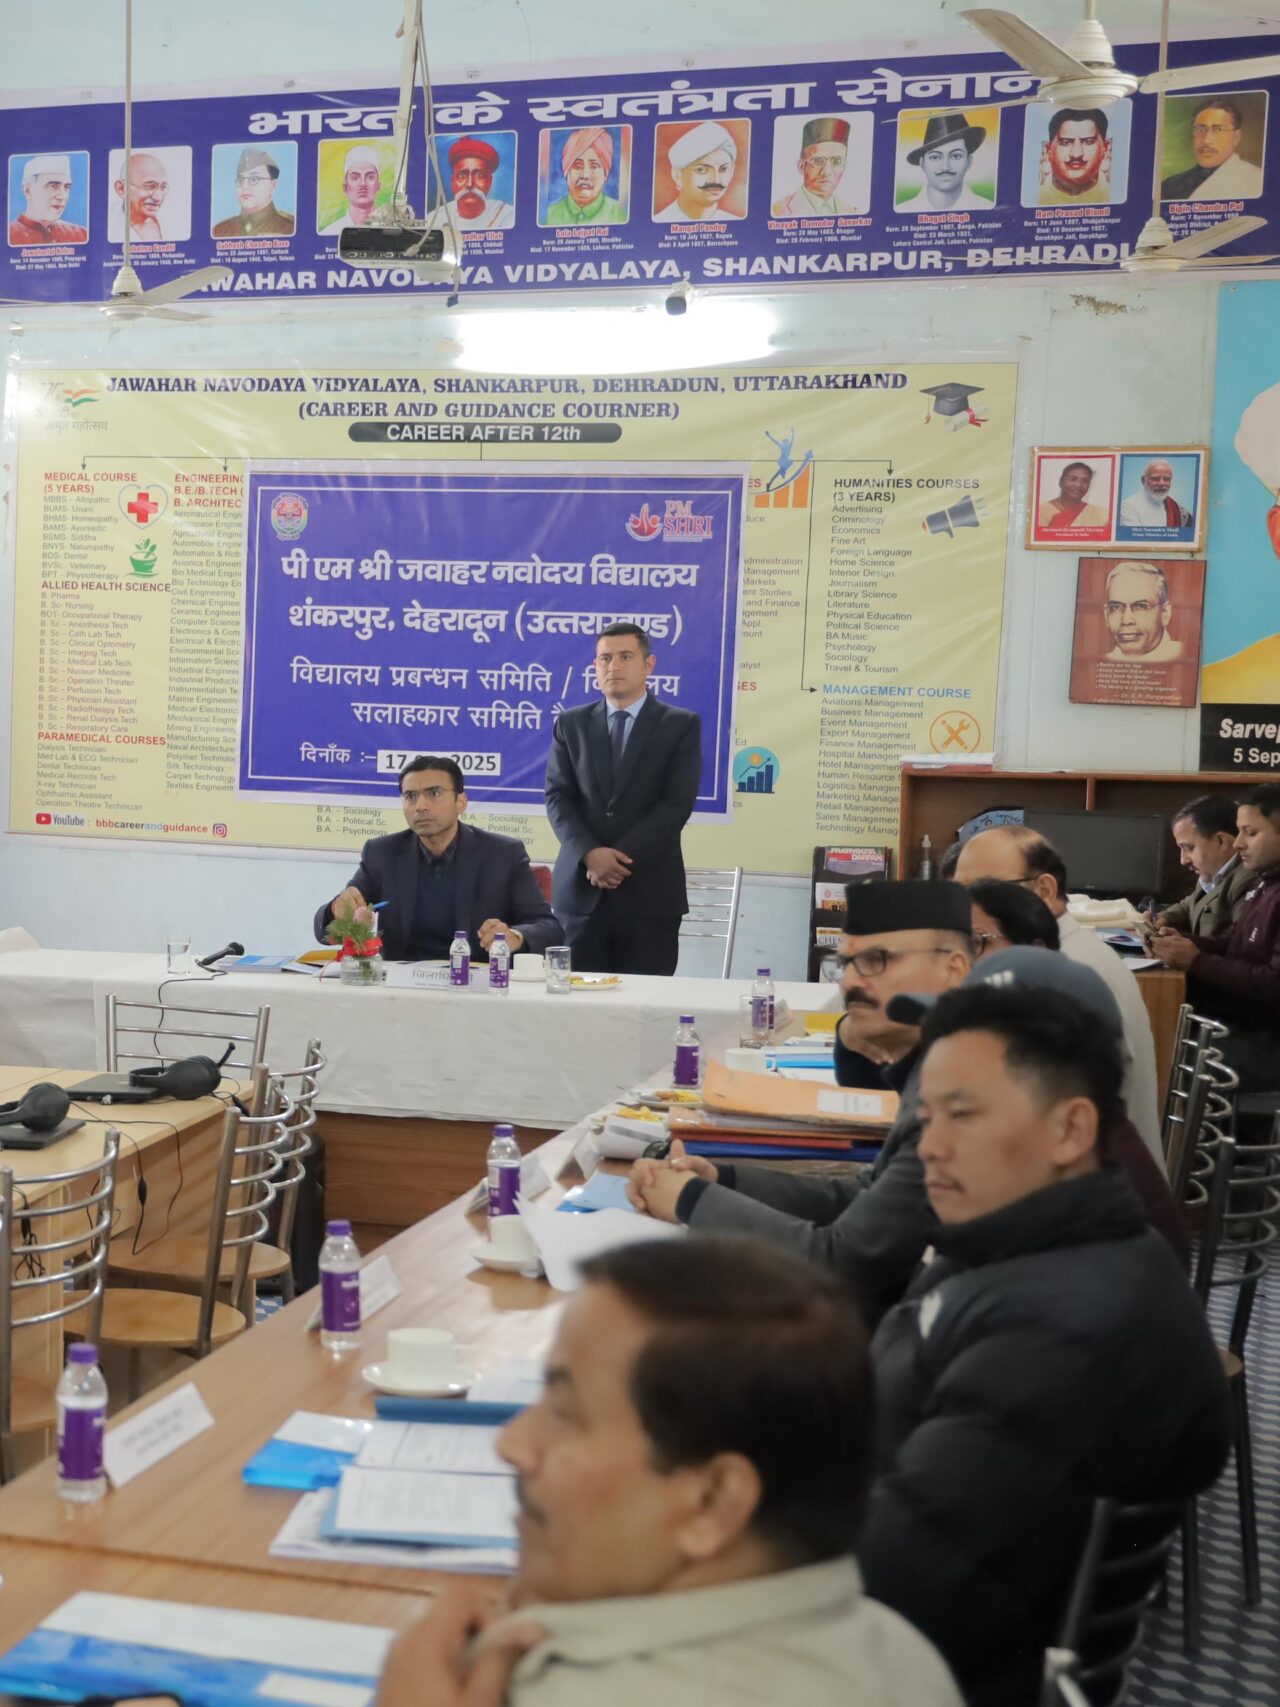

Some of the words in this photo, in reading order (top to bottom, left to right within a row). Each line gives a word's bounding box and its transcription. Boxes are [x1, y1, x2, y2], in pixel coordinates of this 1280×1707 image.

[526, 79, 818, 123] स्वतंत्रता
[1169, 204, 1192, 215] Bipin
[1192, 202, 1228, 213] Chandra
[917, 215, 946, 225] Bhagat
[946, 213, 971, 224] Singh
[671, 224, 699, 235] Mangal
[767, 221, 798, 231] Vinayak
[504, 258, 691, 284] VIDYALAYA,
[703, 250, 954, 277] SHANKARPUR,
[106, 377, 197, 394] JAWAHAR
[203, 376, 307, 394] NAVODAYA
[313, 376, 428, 396] VIDYALAYA,
[433, 376, 586, 396] SHANKARPUR,
[592, 376, 726, 396] DEHRADUN,
[732, 372, 909, 392] UTTARAKHAND
[298, 402, 390, 421] (CAREER
[394, 402, 438, 418] AND
[444, 402, 556, 419] GUIDANCE
[562, 401, 681, 421] COURNER)
[386, 425, 466, 441] CAREER
[469, 424, 534, 441] AFTER
[539, 423, 581, 440] 12th
[44, 472, 91, 482] MEDICAL
[93, 473, 138, 482] COURSE
[55, 484, 95, 494] YEARS)
[833, 478, 913, 489] HUMANITIES
[916, 478, 981, 489] COURSES
[833, 491, 845, 502] (3
[848, 491, 896, 503] YEARS)
[663, 500, 693, 518] PM
[832, 504, 883, 515] Advertising
[661, 514, 714, 535] SHRI
[831, 514, 886, 526] Criminology
[831, 525, 882, 535] Economics
[830, 536, 850, 545] Fine
[852, 536, 866, 545] Art
[830, 547, 865, 558] Foreign
[867, 547, 913, 558] Language
[280, 547, 311, 583] पी
[312, 555, 354, 583] एम
[357, 549, 393, 583] श्री
[396, 556, 490, 586] जवाहर
[491, 553, 583, 586] नवोदय
[590, 553, 701, 589] विद्यालय
[829, 558, 857, 567] Home
[859, 558, 896, 567] Science
[828, 568, 860, 578] Interior
[862, 568, 895, 579] Design
[41, 580, 79, 591] ALLIED
[81, 581, 123, 592] HEALTH
[125, 581, 171, 593] SCIENCE
[827, 579, 878, 588] Journalism
[827, 590, 859, 601] Library
[860, 590, 898, 600] Science
[826, 600, 871, 609] Literature
[288, 597, 396, 642] शंकरपुर,
[826, 611, 865, 621] Physical
[867, 611, 913, 621] Education
[825, 621, 862, 630] Political
[863, 622, 900, 631] Science
[825, 632, 840, 640] BA
[841, 632, 868, 641] Music
[825, 642, 878, 653] Psychology
[824, 652, 869, 663] Sociology
[824, 663, 852, 673] Travel
[853, 664, 861, 673] &
[863, 665, 900, 674] Tourism
[289, 655, 381, 689] विद्यालय
[390, 664, 469, 694] प्रबन्धन
[477, 661, 553, 695] समिति
[822, 684, 914, 696] MANAGEMENT
[916, 687, 973, 699] COURSE
[820, 697, 863, 707] Aviations
[864, 698, 925, 710] Management
[350, 701, 461, 729] सलाहकार
[468, 699, 543, 731] समिति
[820, 707, 861, 718] Business
[863, 708, 924, 720] Management
[37, 732, 113, 744] PARAMEDICAL
[115, 734, 167, 746] COURSES
[1233, 747, 1244, 763] 5
[52, 814, 86, 827] YouTube
